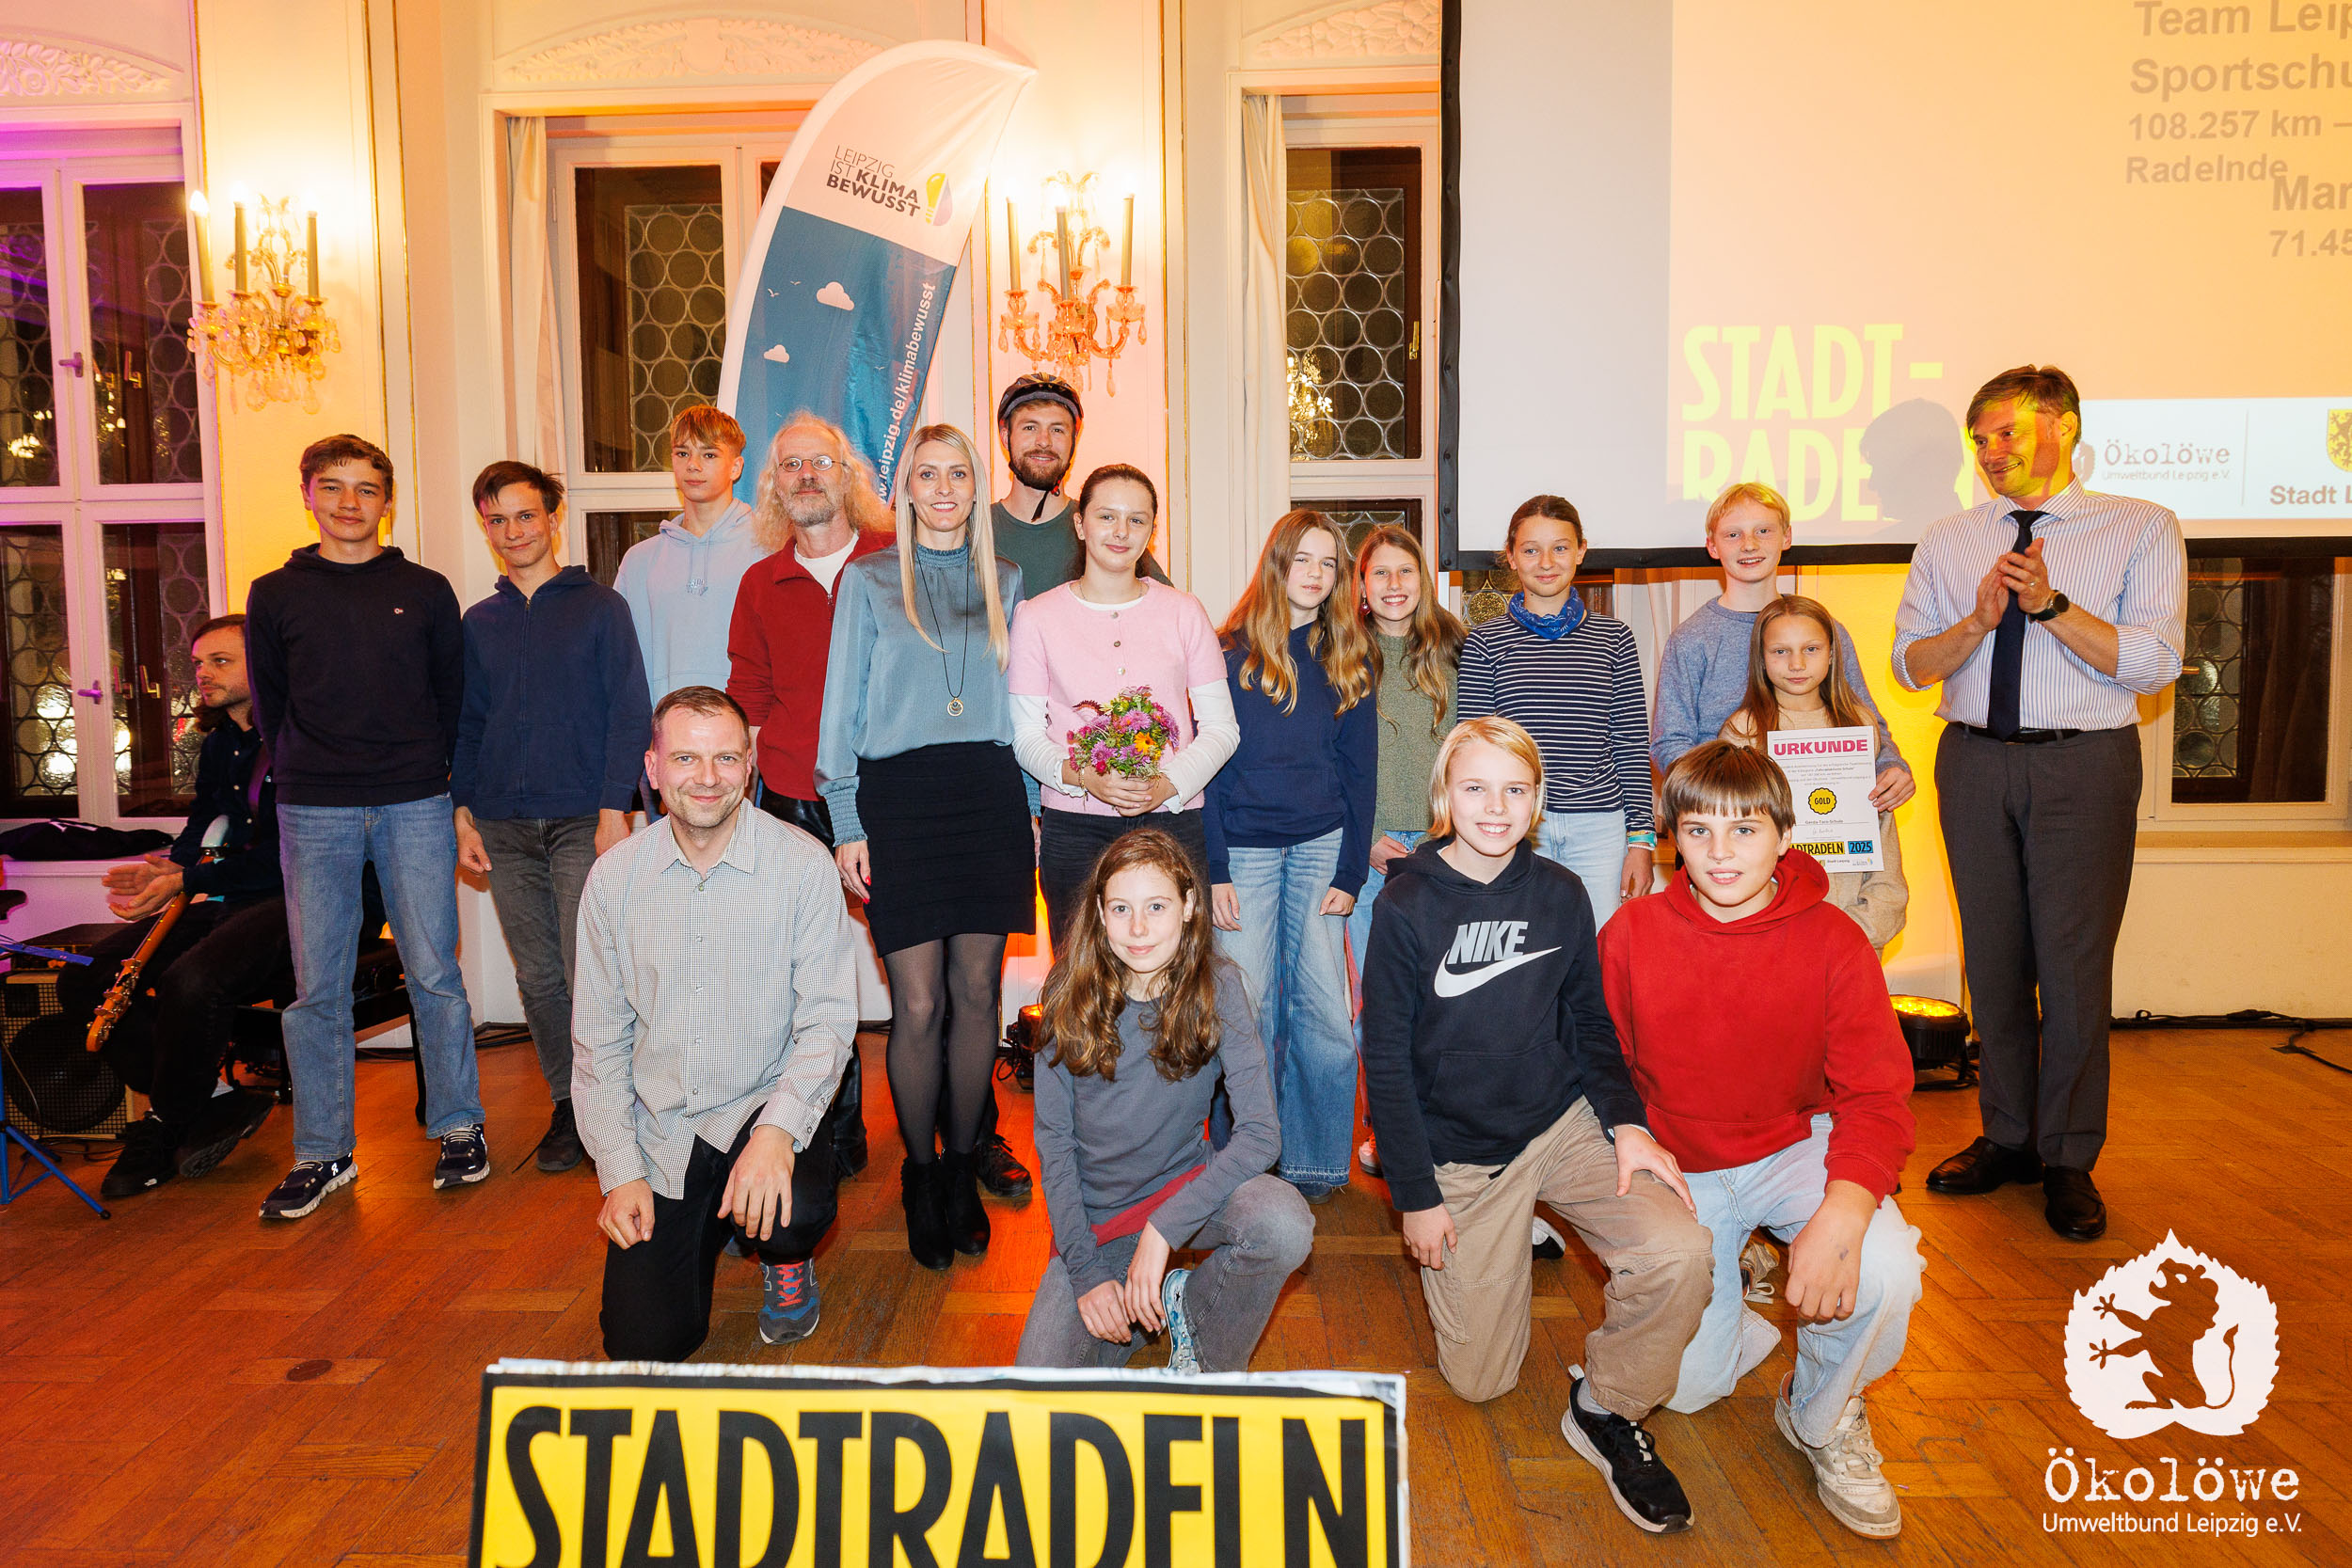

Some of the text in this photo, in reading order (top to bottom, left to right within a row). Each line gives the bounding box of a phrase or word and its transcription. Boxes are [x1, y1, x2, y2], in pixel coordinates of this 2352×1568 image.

[2134, 0, 2251, 36] Team
[2128, 109, 2260, 140] 108.257
[2270, 109, 2322, 137] km
[834, 145, 896, 179] LEIPZIG
[2125, 152, 2289, 183] Radelnde
[826, 173, 921, 217] BEWUSST
[830, 159, 919, 204] IST KLIMA
[878, 282, 937, 505] w.leipzig.de/klimabewusst
[2104, 438, 2231, 467] Ökolöwe
[2269, 484, 2337, 505] Stadt
[1773, 739, 1868, 756] URKUNDE
[1814, 797, 1831, 805] GOLD
[1849, 842, 1872, 853] 2025
[1446, 920, 1529, 965] NIKE
